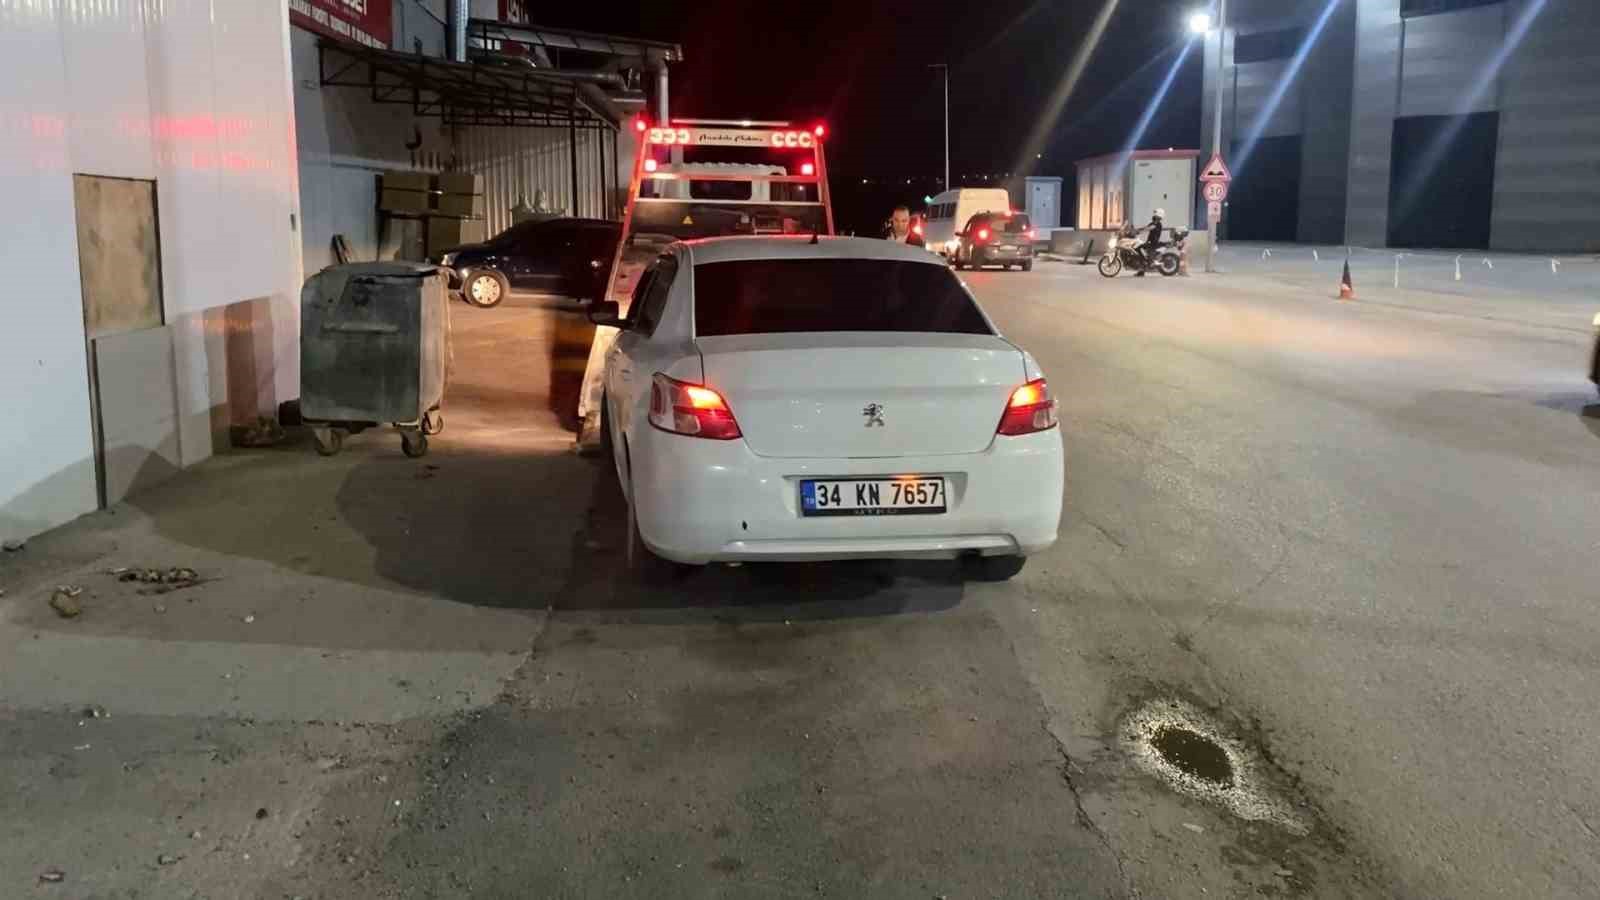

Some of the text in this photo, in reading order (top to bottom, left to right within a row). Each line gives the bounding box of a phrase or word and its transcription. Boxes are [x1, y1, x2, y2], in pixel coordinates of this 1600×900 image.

[1210, 186, 1222, 196] 30
[817, 484, 841, 507] 34
[855, 483, 881, 506] KN
[890, 482, 939, 505] 7657
